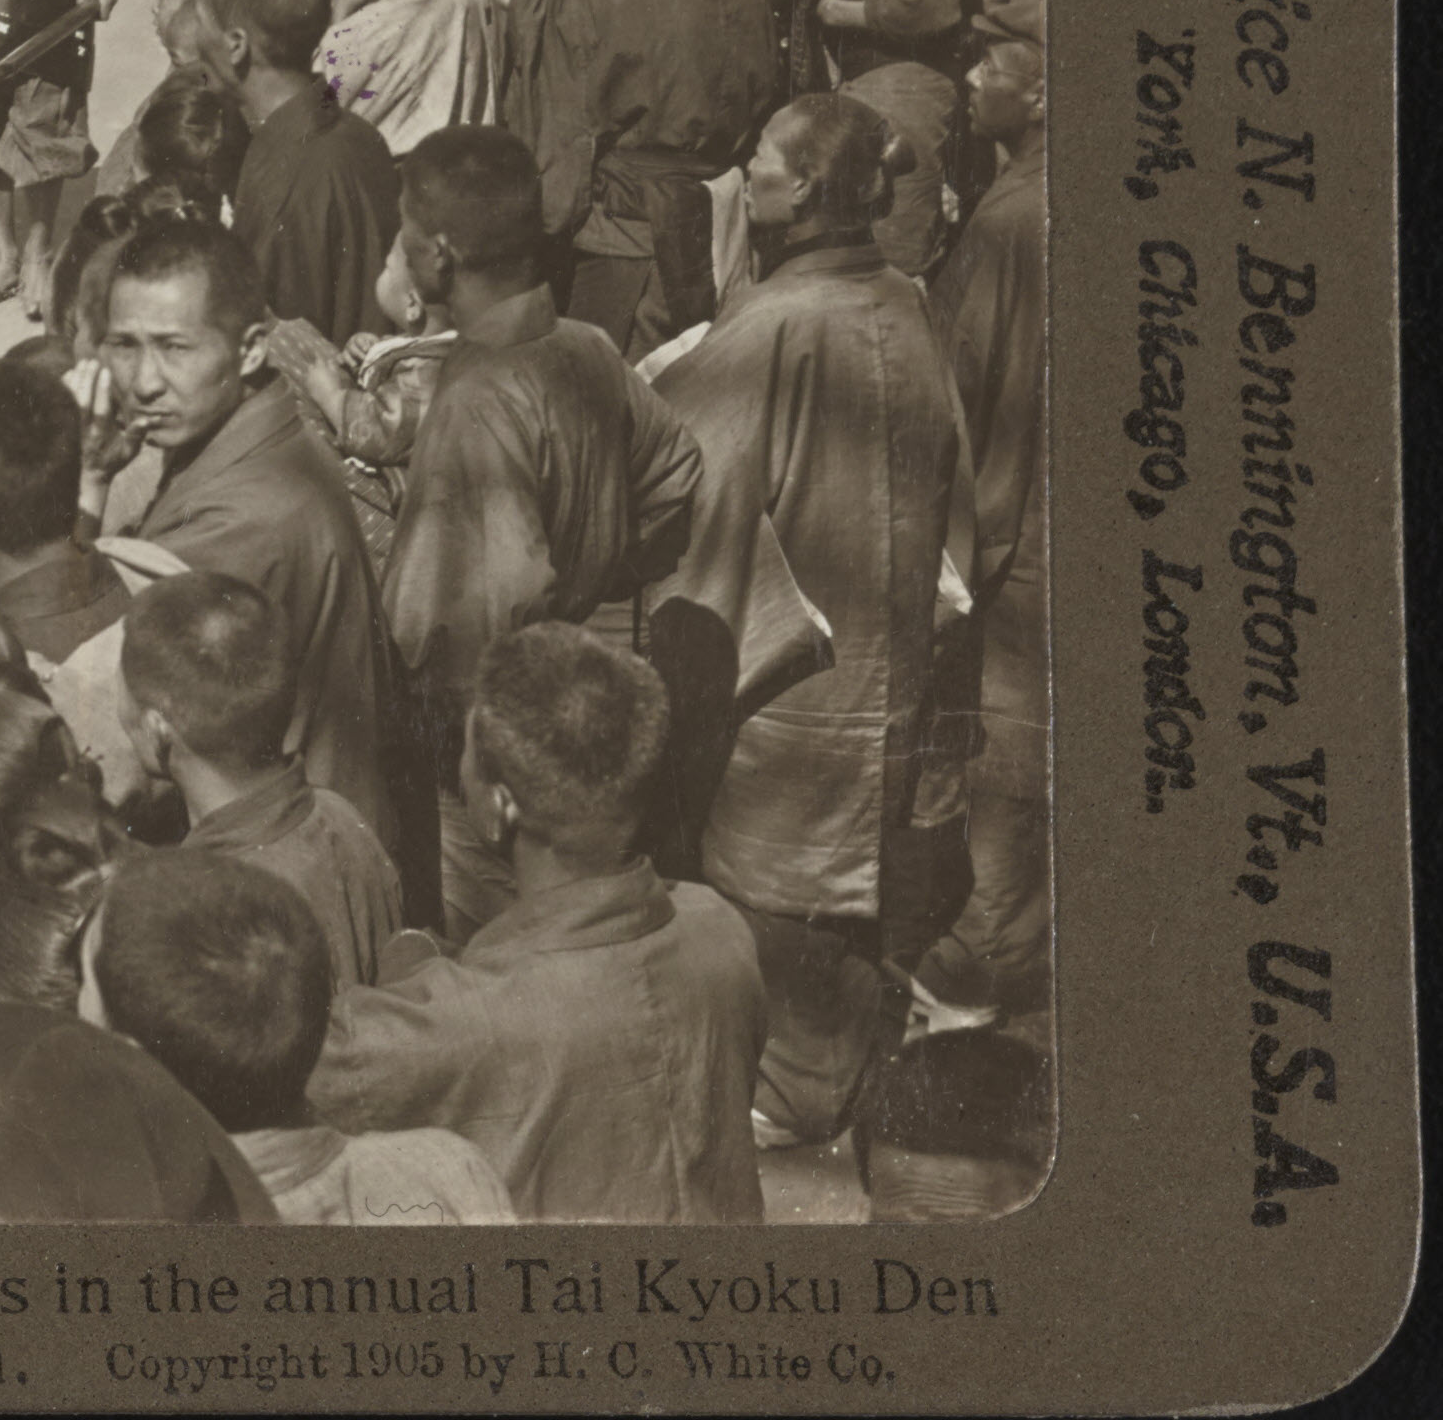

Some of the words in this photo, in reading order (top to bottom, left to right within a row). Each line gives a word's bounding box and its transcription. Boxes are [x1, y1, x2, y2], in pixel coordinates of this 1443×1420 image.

[1124, 29, 1197, 200] York,
[1236, 118, 1316, 210] N.
[1123, 241, 1200, 520] Chicago,
[1142, 549, 1207, 815] London.
[1247, 940, 1341, 1229] U.S.A.
